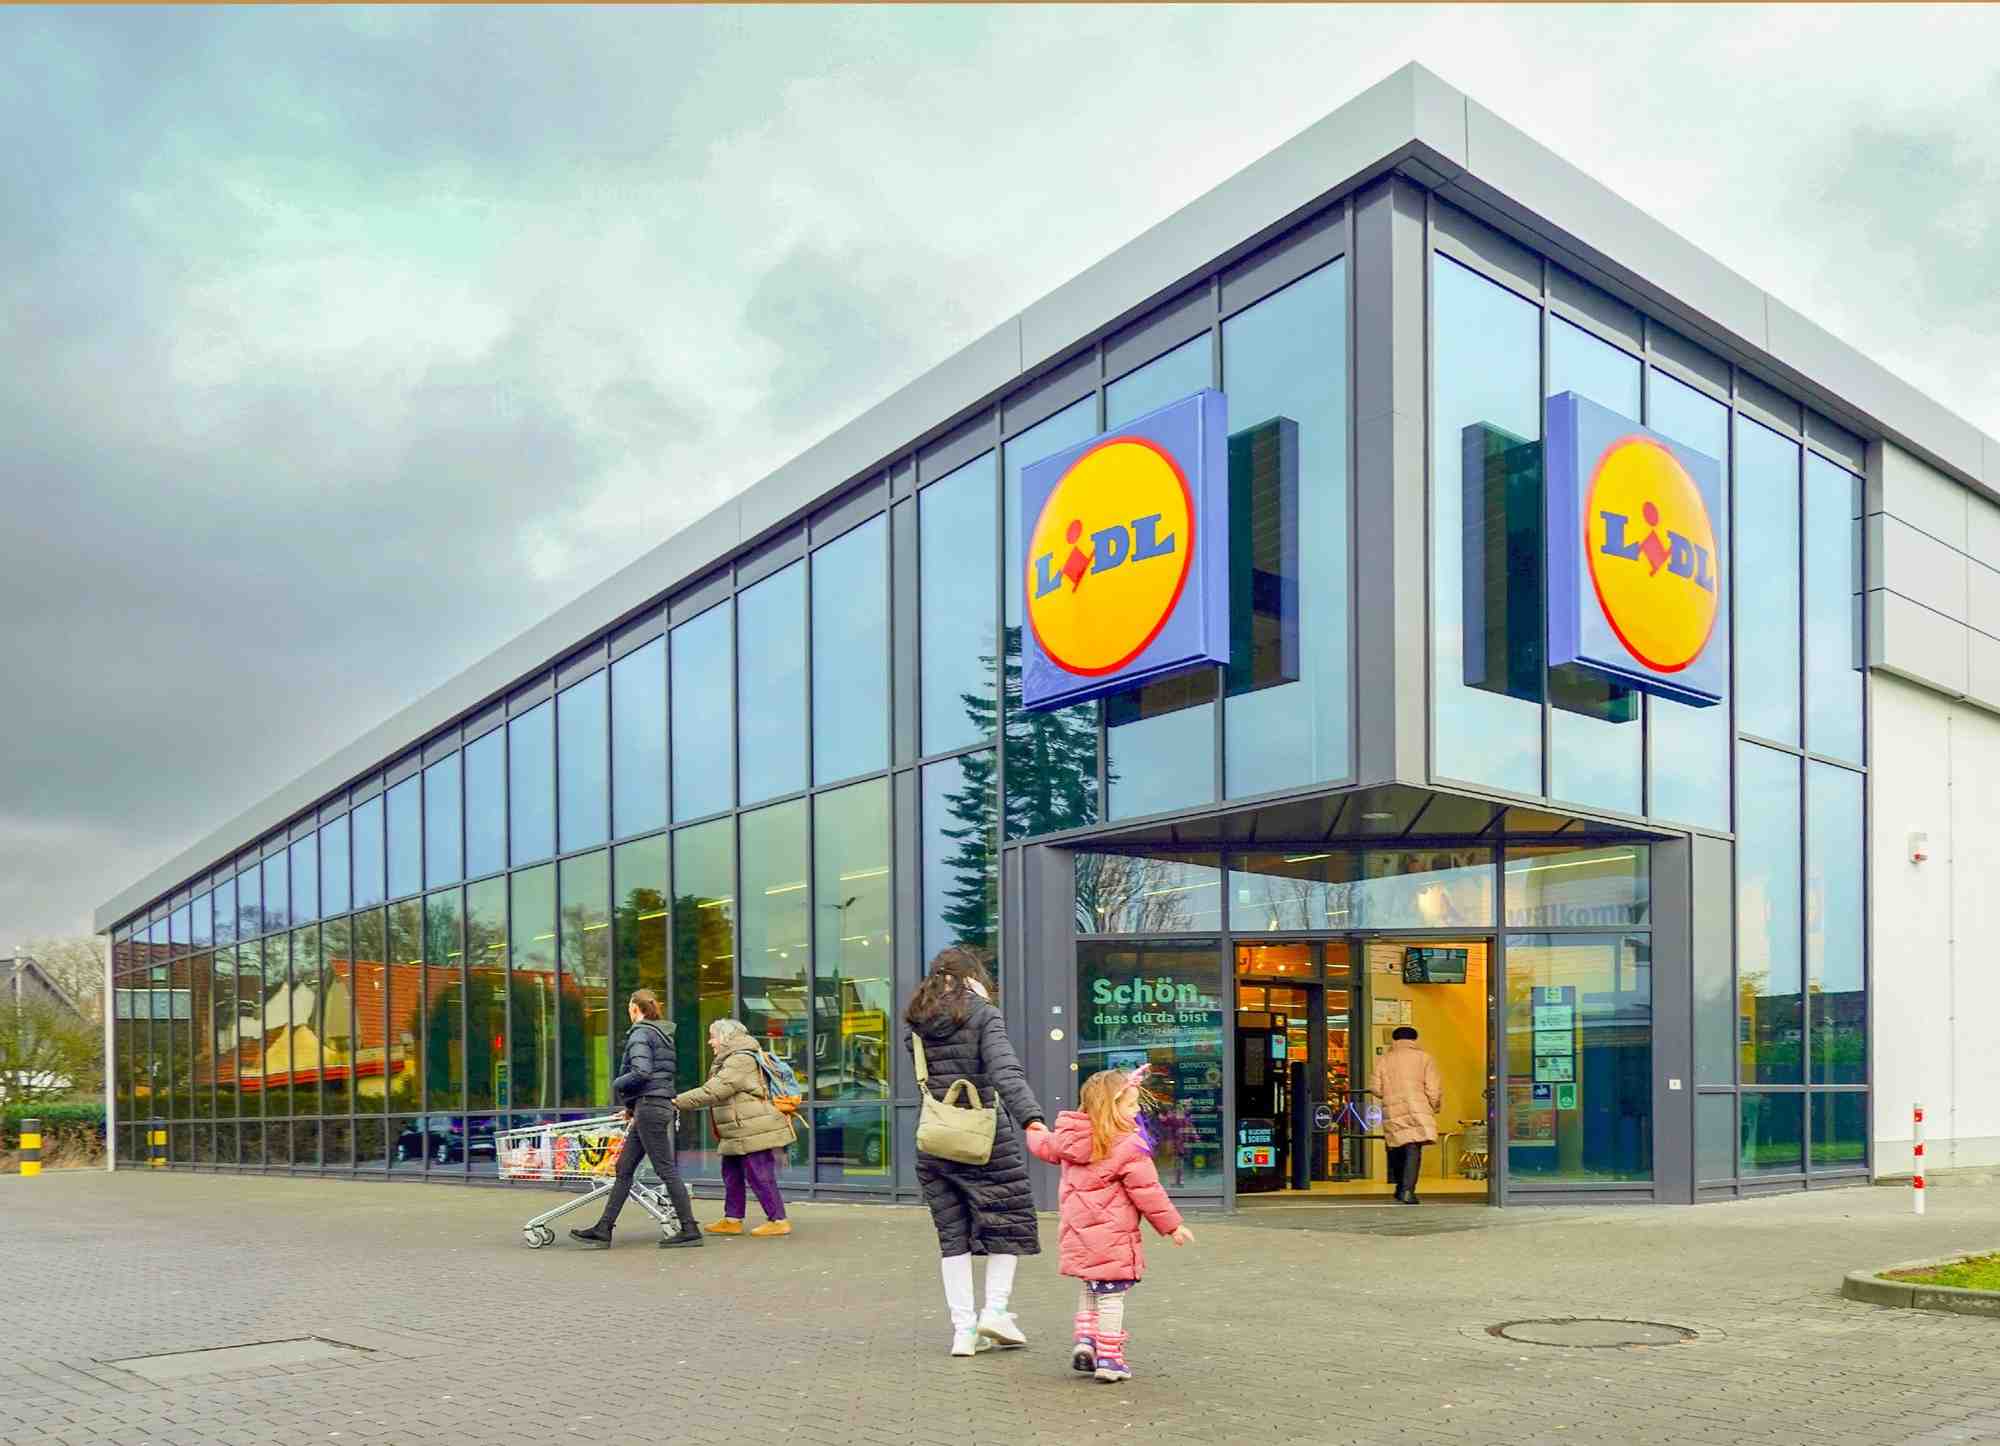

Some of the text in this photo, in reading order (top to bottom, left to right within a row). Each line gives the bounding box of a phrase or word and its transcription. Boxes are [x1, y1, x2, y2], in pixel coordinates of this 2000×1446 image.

[1093, 976, 1209, 1005] Schön,
[1094, 1010, 1209, 1025] dass du da bist
